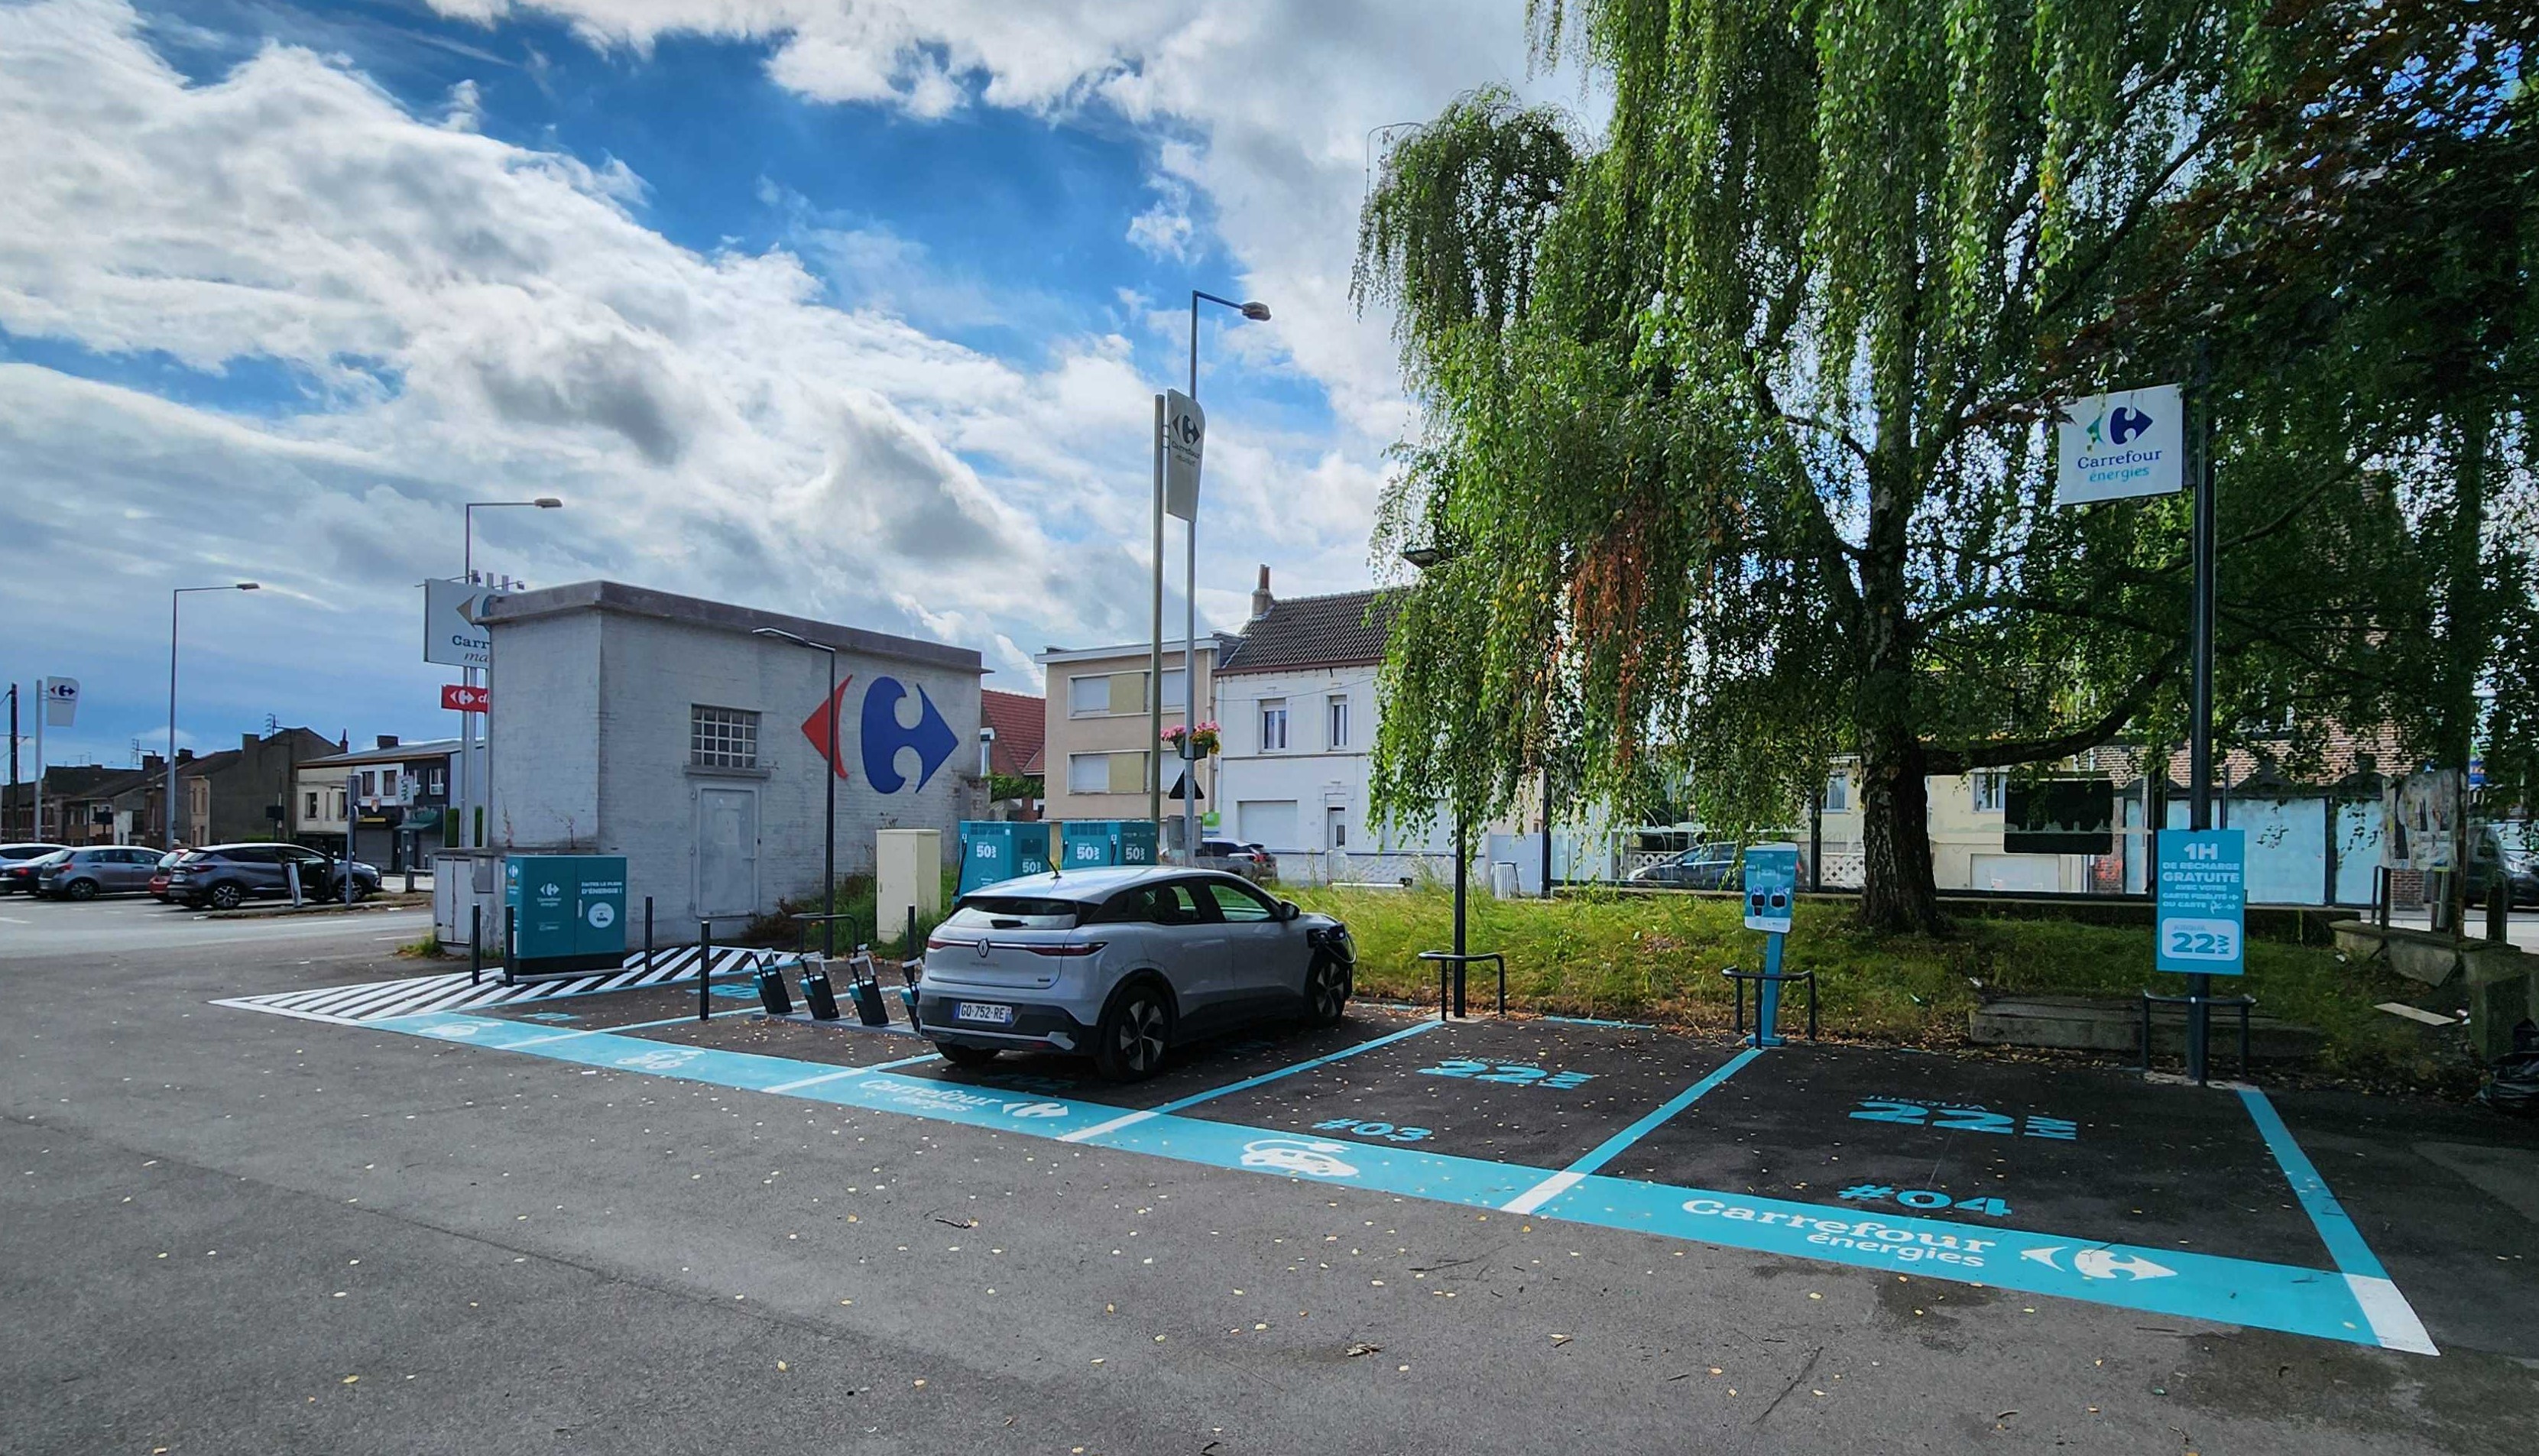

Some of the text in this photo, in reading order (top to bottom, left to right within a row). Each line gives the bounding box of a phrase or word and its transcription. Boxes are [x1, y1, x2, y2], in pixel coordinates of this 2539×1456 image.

[2077, 450, 2162, 469] Carrefour
[2090, 466, 2149, 482] énergies
[976, 845, 991, 858] 50
[1076, 846, 1093, 860] 50
[1126, 847, 1140, 861] 50
[2184, 842, 2218, 861] 1H
[1022, 861, 1036, 873] 50
[2180, 862, 2239, 871] RECHARGE
[2162, 872, 2239, 883] GRATUITE
[2171, 932, 2216, 954] 22
[1416, 1060, 1548, 1085] 22
[858, 1079, 1002, 1107] Carrefour
[1848, 1101, 2015, 1134] 22
[1312, 1117, 1433, 1142] #03
[1837, 1183, 2013, 1218] #04
[1681, 1199, 1997, 1254] Carrefour
[1806, 1231, 1985, 1268] énergies
